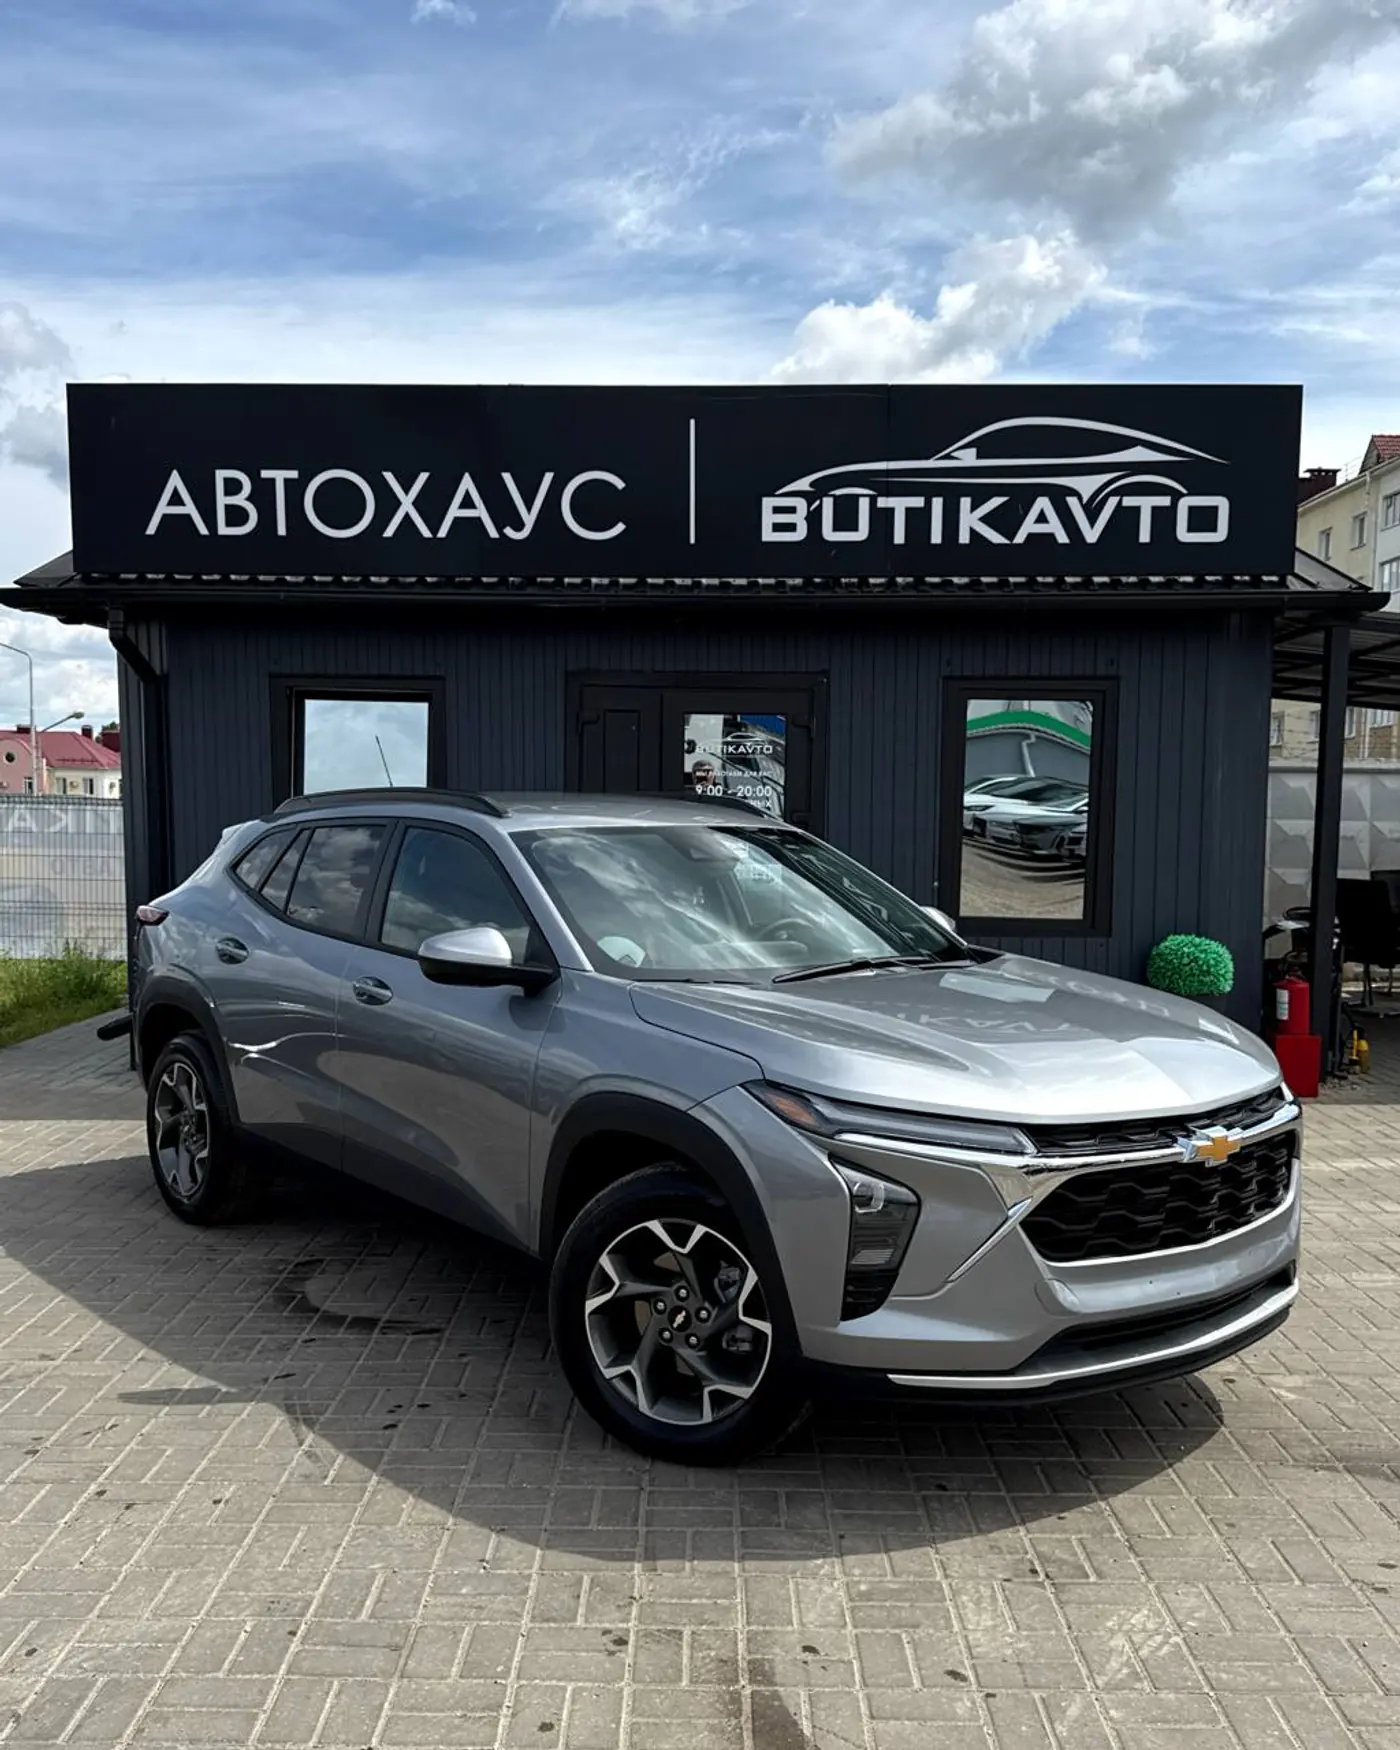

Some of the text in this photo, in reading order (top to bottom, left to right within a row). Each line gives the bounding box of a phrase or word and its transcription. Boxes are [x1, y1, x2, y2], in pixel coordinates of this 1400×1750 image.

[145, 469, 627, 541] АВТОХАУС
[761, 494, 1230, 545] BUTIKAVTO
[695, 784, 723, 797] 9:00
[737, 785, 772, 797] 20:00
